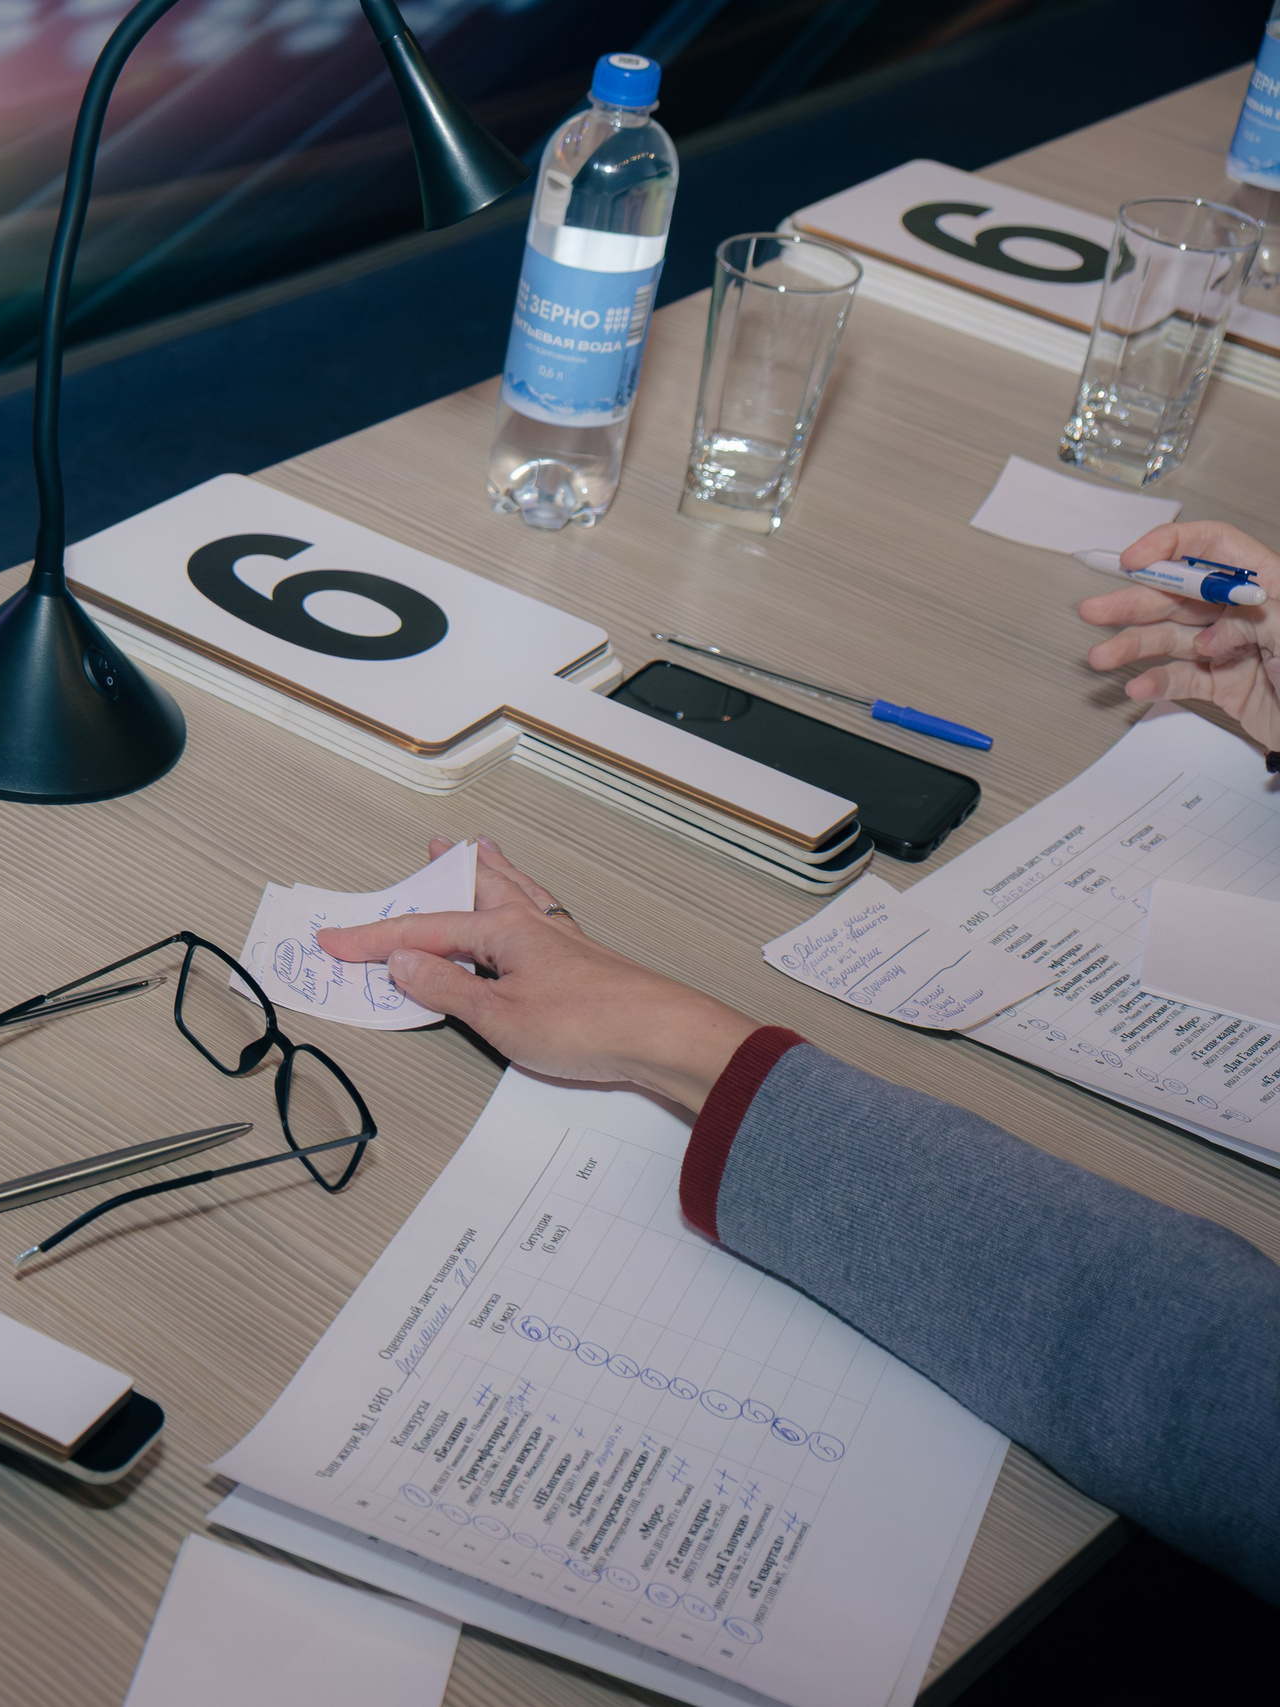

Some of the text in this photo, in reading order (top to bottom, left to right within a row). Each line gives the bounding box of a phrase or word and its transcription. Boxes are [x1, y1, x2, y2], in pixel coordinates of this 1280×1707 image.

[902, 202, 1112, 284] 6
[529, 294, 600, 330] ЗЕРНО
[577, 340, 622, 354] ВОДА
[188, 534, 447, 661] 6
[957, 909, 991, 932] 2 ФИО
[1002, 931, 1034, 953] оманды
[1084, 972, 1135, 1005] «НЕлогика»
[1169, 1014, 1207, 1037] «Морс»
[574, 1155, 600, 1181] Итог
[517, 1210, 557, 1254] Ситуация
[539, 1241, 558, 1255] (6
[375, 1226, 481, 1361] Оценочный лист членов жюри
[467, 1290, 503, 1329] Визитка
[487, 1320, 509, 1336] (6
[314, 1457, 343, 1482] Член
[333, 1433, 365, 1463] жюри
[350, 1419, 371, 1435] №
[363, 1384, 396, 1415] ФИО
[389, 1398, 435, 1449] Конкурсы
[410, 1408, 452, 1454] Команды
[429, 1414, 471, 1464] «Беляши»
[453, 1413, 516, 1492] «Триумфаторы»
[485, 1462, 523, 1506] «Дальше
[512, 1424, 549, 1466] некуда»
[529, 1450, 575, 1511] «НЕлогика»
[563, 1468, 604, 1519] «Детство»
[576, 1490, 630, 1563] «Чистогорские
[618, 1448, 652, 1493] сосиски»
[635, 1500, 670, 1542] «Морс»
[662, 1496, 717, 1576] «Те еще кадры»
[702, 1511, 752, 1590] «Для Галочки»
[743, 1533, 789, 1600] «43 квартал»
